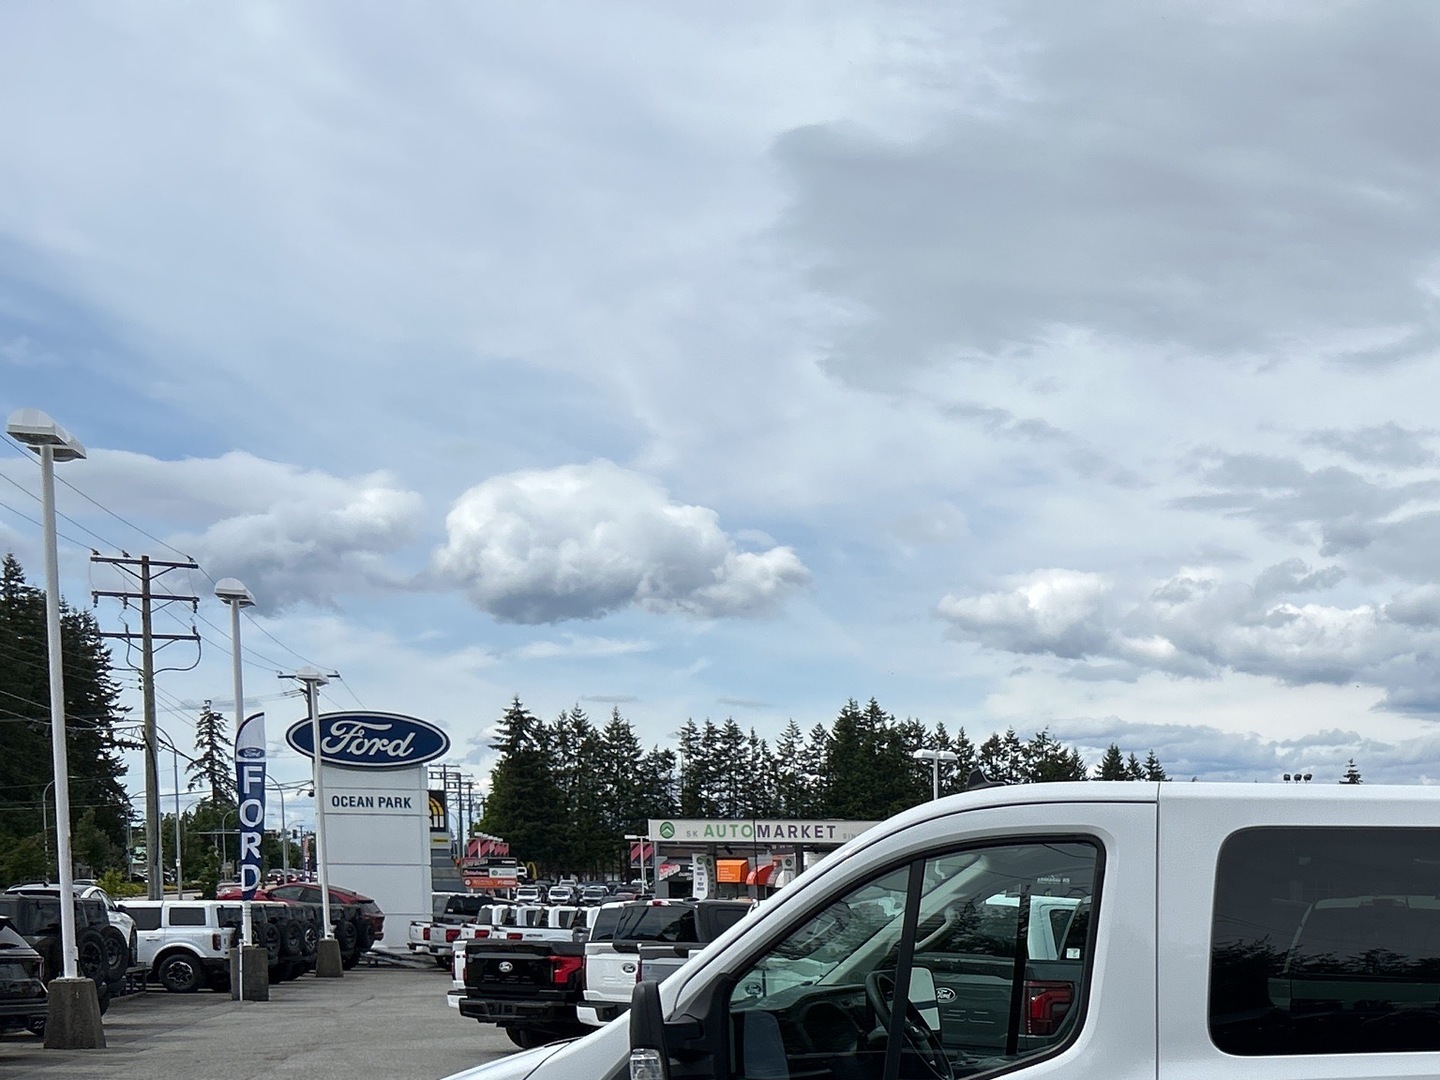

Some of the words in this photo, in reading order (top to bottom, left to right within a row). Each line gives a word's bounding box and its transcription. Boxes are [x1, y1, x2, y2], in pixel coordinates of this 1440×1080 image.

[321, 720, 416, 757] Ford
[331, 795, 374, 808] OCEAN
[378, 796, 412, 809] PARK
[239, 765, 264, 892] FORD
